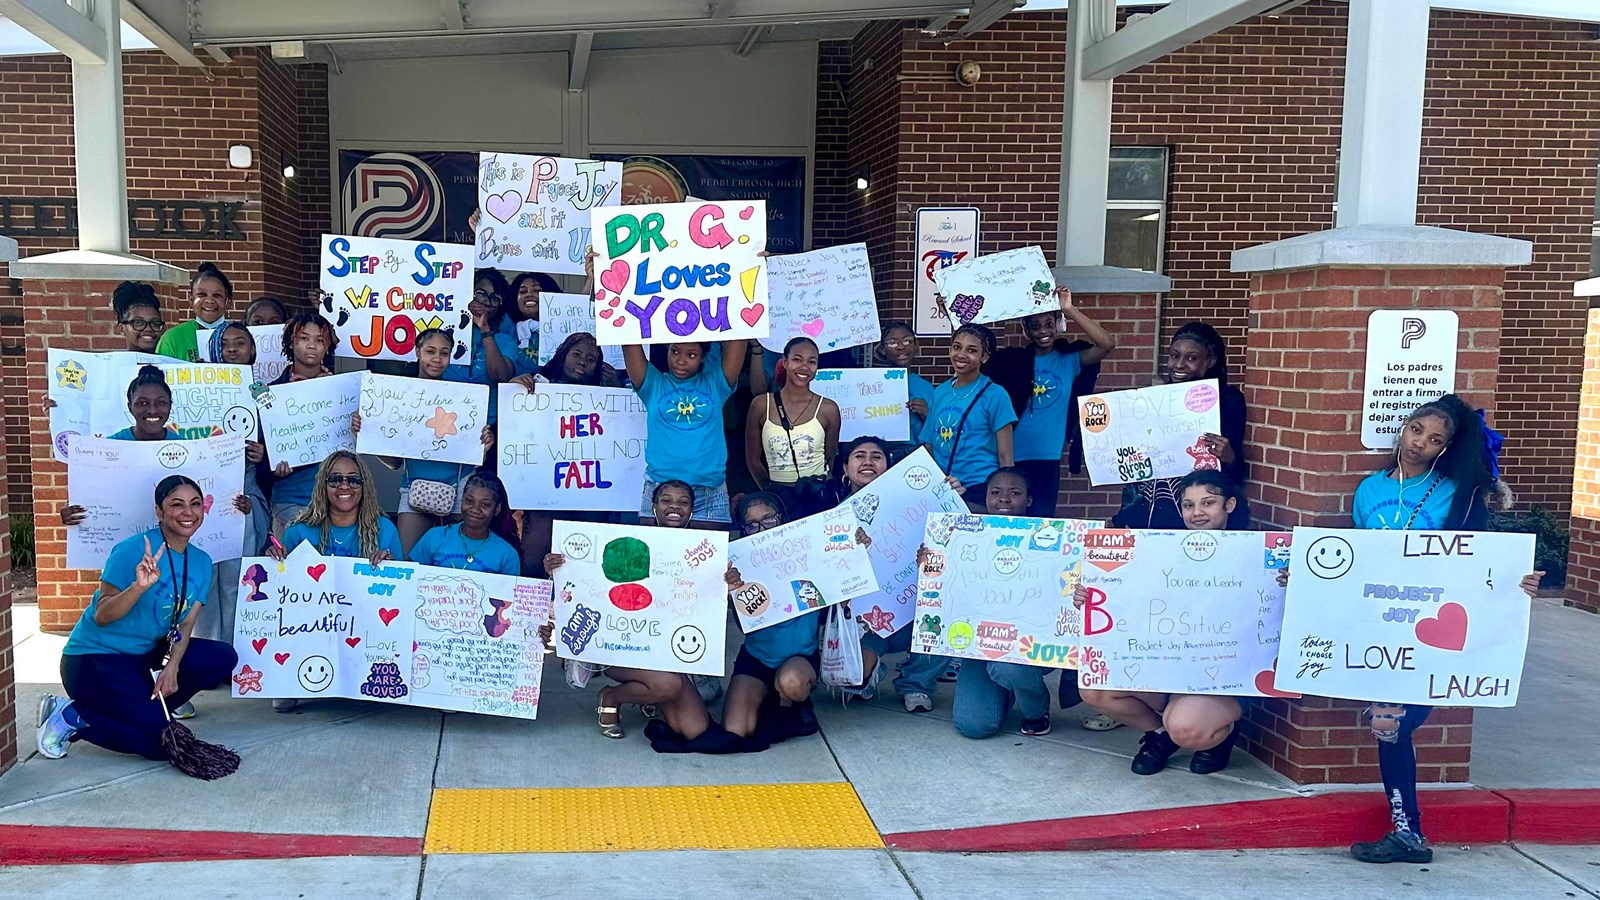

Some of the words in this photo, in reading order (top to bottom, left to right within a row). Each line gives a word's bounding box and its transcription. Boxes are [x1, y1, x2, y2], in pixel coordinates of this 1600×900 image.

[511, 162, 524, 181] is
[525, 157, 579, 205] Project
[568, 161, 618, 211] Joy
[777, 180, 802, 188] HIGH
[518, 207, 547, 229] and
[550, 210, 567, 229] it
[605, 213, 678, 260] DR.
[688, 204, 750, 249] G.
[479, 227, 522, 263] Begins
[531, 237, 560, 260] with
[379, 249, 408, 273] By
[777, 257, 811, 271] Project
[819, 252, 839, 266] Joy
[635, 257, 731, 296] Loves
[543, 295, 562, 317] You
[566, 304, 583, 317] are
[951, 294, 966, 311] YOU
[959, 299, 973, 318] ARE
[961, 297, 985, 323] LOVED
[625, 296, 732, 339] YOU
[166, 367, 243, 386] INIONS
[883, 370, 906, 380] JOY
[1387, 363, 1405, 371] Los
[1408, 362, 1443, 372] padres
[825, 384, 850, 398] LET
[857, 382, 884, 396] YOUR
[1383, 376, 1415, 384] tienen
[1418, 377, 1438, 385] que
[172, 387, 241, 407] IGHT
[411, 389, 454, 409] Future
[1372, 389, 1404, 397] entrar
[1415, 388, 1446, 397] firmar
[286, 398, 333, 416] Become
[340, 394, 358, 405] the
[513, 393, 550, 412] GOD
[555, 392, 583, 413] IS
[863, 403, 903, 420] SHINE
[1086, 402, 1105, 416] YOU
[1117, 390, 1185, 420] LOVE
[1369, 401, 1378, 409] el
[388, 406, 430, 428] Bright
[560, 413, 604, 439] HER
[1085, 414, 1108, 428] ROCK!
[1369, 412, 1395, 423] dejar
[1158, 416, 1206, 439] yourself
[276, 438, 300, 453] and
[305, 433, 330, 447] most
[299, 446, 316, 463] of
[502, 443, 538, 466] SHE
[547, 441, 606, 460] WILL
[1116, 446, 1137, 463] you
[1126, 453, 1144, 463] ARE
[554, 460, 613, 489] FAIL
[1118, 457, 1154, 481] Strong
[903, 497, 933, 527] YOUR
[825, 524, 851, 535] YOU
[982, 516, 1043, 529] PROJECT
[684, 538, 710, 560] choose
[995, 534, 1024, 547] JOY
[1093, 534, 1125, 547] I'AM
[1402, 534, 1474, 557] LIVE
[751, 535, 812, 568] CHOOSE
[927, 552, 943, 565] YOU
[1087, 549, 1130, 562] beautiful
[353, 562, 414, 580] PROJECT
[772, 553, 809, 580] JOY
[924, 563, 944, 573] ROCK!
[920, 581, 943, 591] YOU
[1162, 568, 1184, 589] You
[1184, 578, 1200, 588] are
[1204, 580, 1211, 588] a
[278, 585, 312, 604] You
[318, 591, 352, 606] Are
[367, 582, 397, 597] JOY
[737, 584, 760, 606] YOU
[1257, 589, 1276, 604] You
[1362, 583, 1444, 602] PROJECT
[745, 590, 769, 615] ROCK!
[1084, 587, 1129, 636] Be
[261, 610, 278, 622] Got
[277, 607, 354, 637] beautiful
[569, 611, 585, 632] am
[1257, 619, 1265, 630] A
[1382, 607, 1420, 623] JOY
[259, 627, 277, 638] Girl
[573, 609, 600, 654] enough
[606, 613, 661, 637] LOVE
[984, 626, 1009, 637] I'AM
[365, 630, 397, 652] LOVE
[1128, 638, 1163, 652] Project
[1168, 641, 1180, 651] Joy
[1257, 632, 1281, 645] Lead
[1299, 635, 1336, 651] today
[1029, 643, 1070, 662] JOY
[1083, 646, 1103, 662] You
[1306, 651, 1333, 660] CHOOSE
[1345, 643, 1415, 670] LOVE
[374, 664, 397, 674] YOU
[1090, 659, 1106, 674] Go
[1295, 658, 1332, 679] joy
[374, 675, 397, 685] ARE
[1082, 673, 1108, 687] Girl!
[1428, 673, 1509, 699] LAUGH
[365, 684, 403, 697] LOVED
